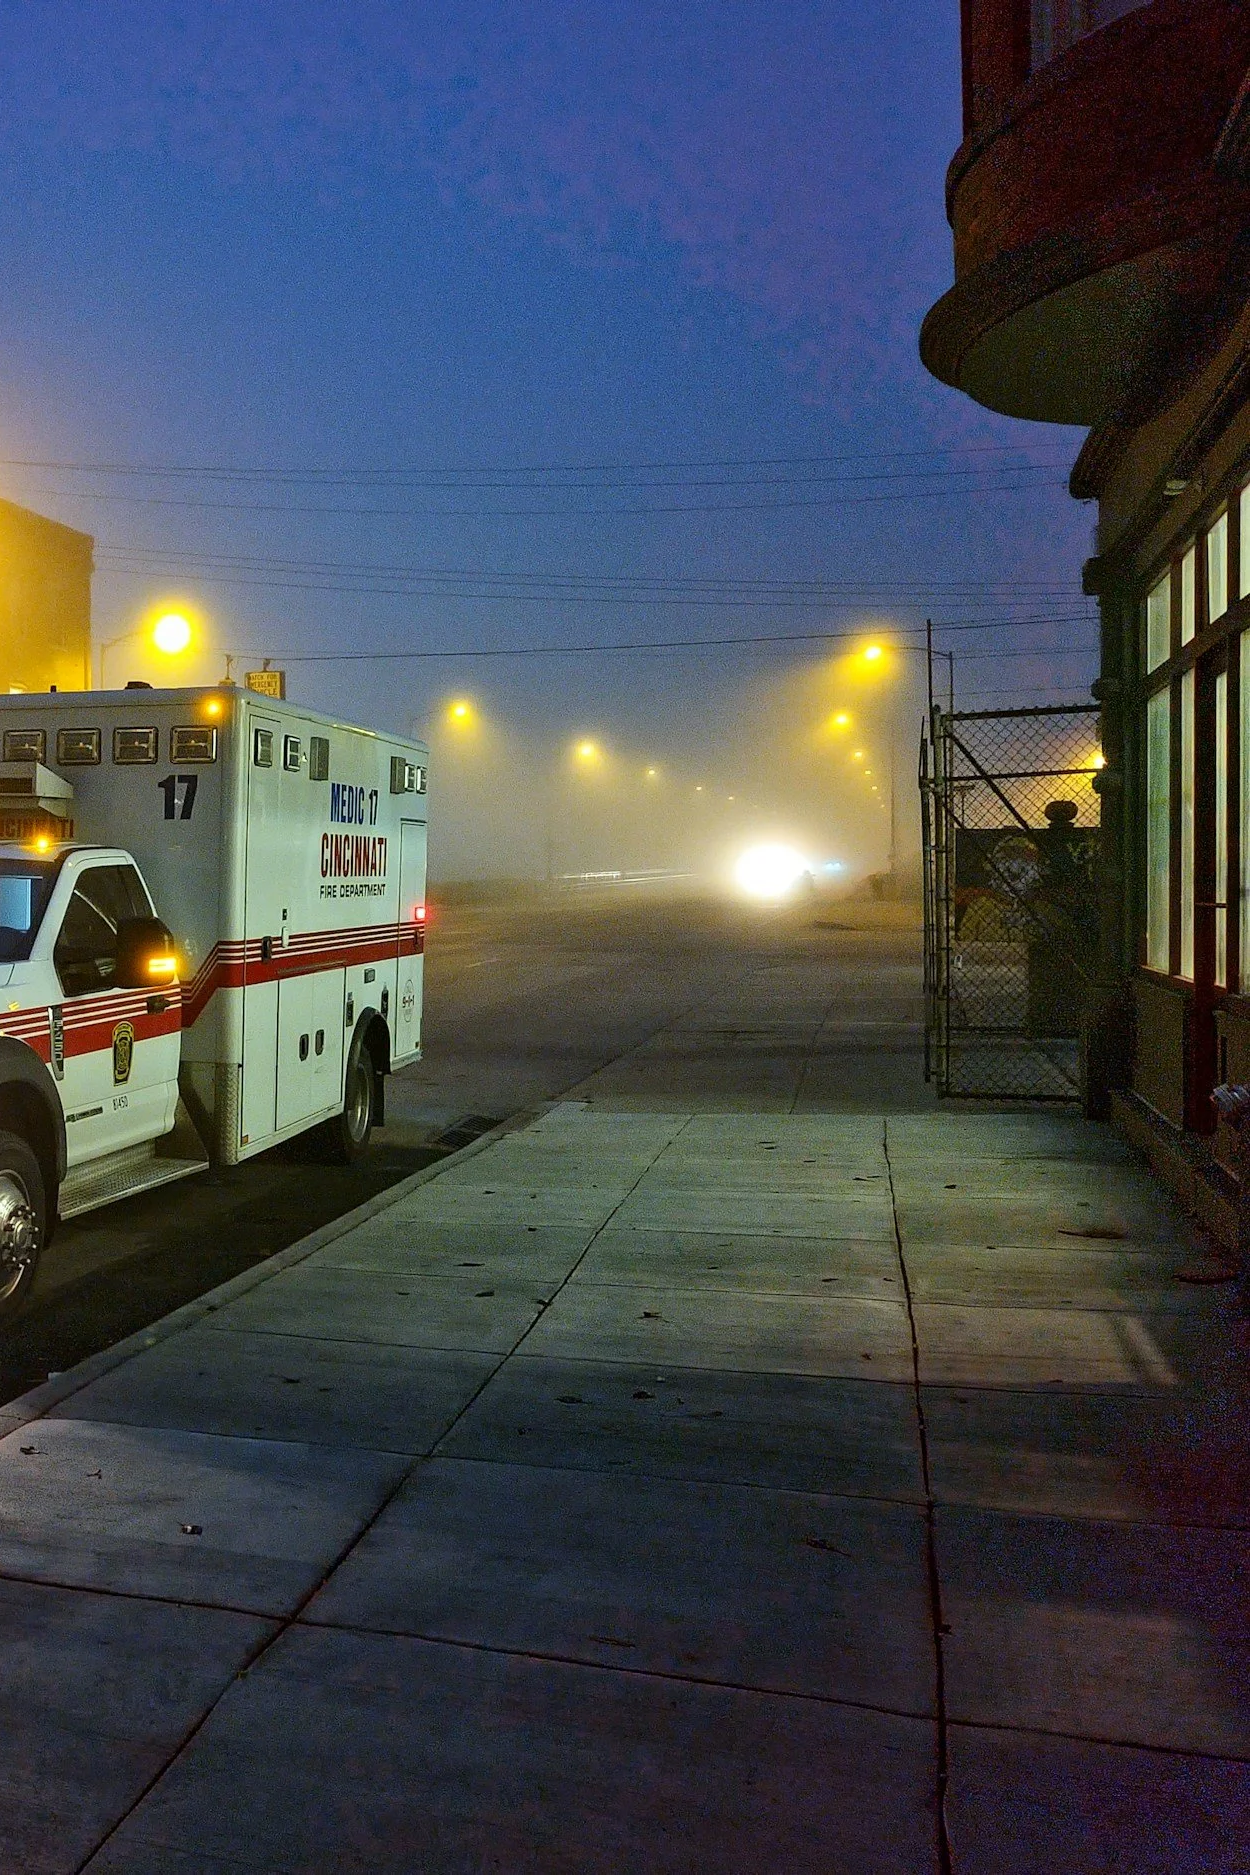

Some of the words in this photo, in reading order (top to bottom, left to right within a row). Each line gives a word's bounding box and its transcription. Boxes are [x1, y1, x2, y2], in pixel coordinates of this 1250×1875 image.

[158, 775, 197, 819] 17
[331, 783, 364, 825] MEDIC
[368, 789, 379, 825] 17
[321, 833, 387, 877] CINCINNATI
[320, 885, 337, 899] FIRE
[340, 884, 386, 898] DEPARTMENT
[113, 1096, 128, 1110] 81450
